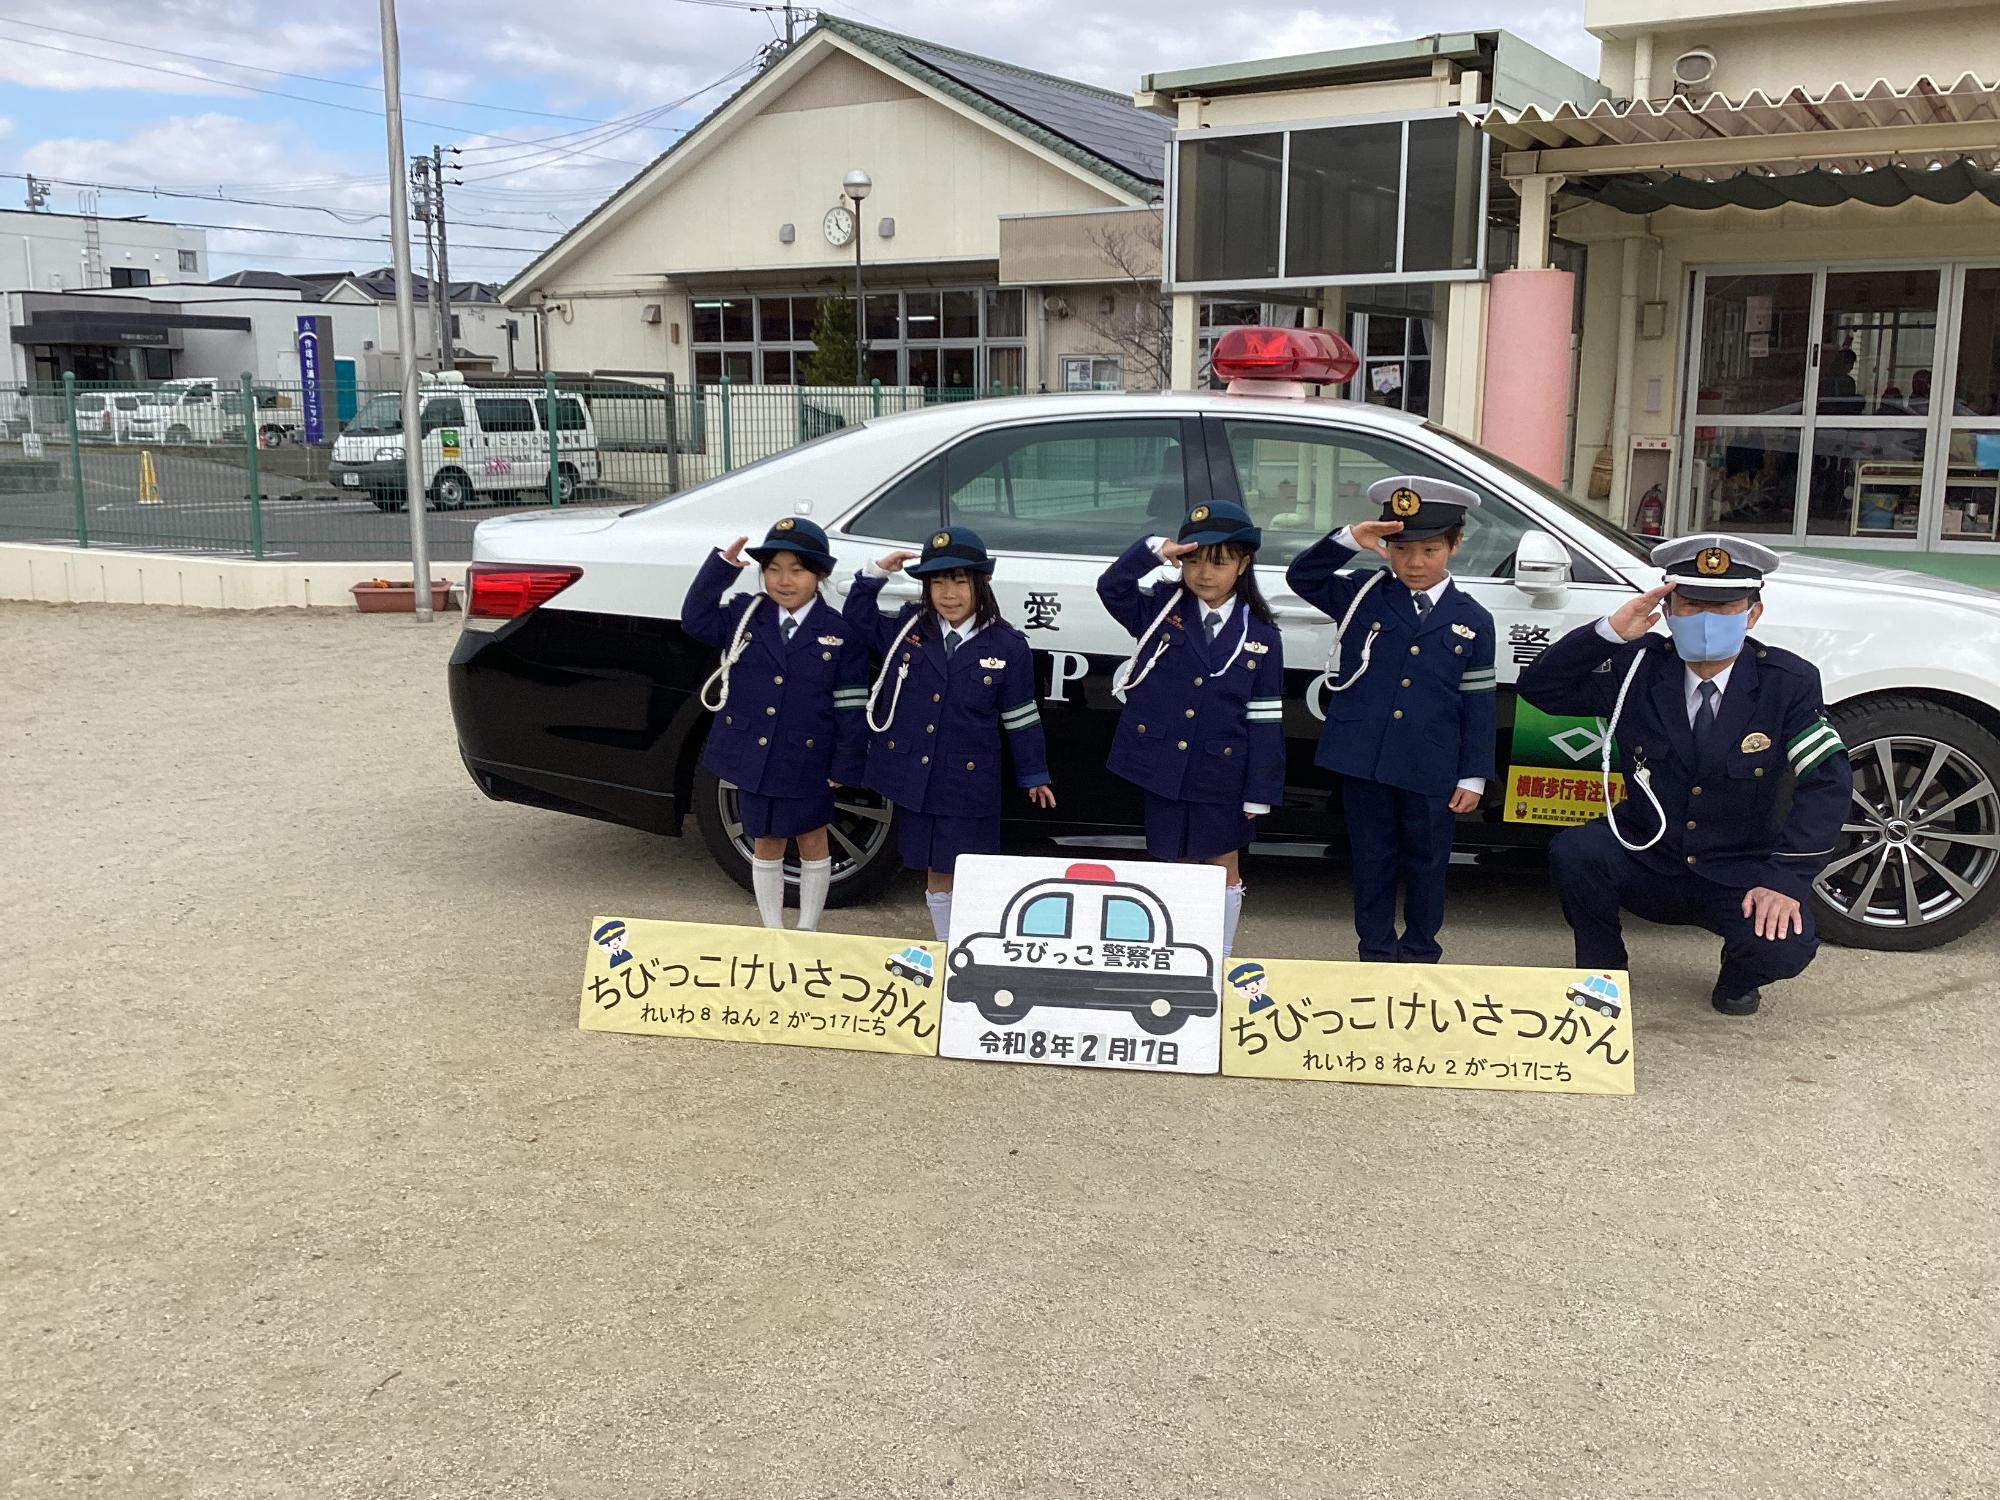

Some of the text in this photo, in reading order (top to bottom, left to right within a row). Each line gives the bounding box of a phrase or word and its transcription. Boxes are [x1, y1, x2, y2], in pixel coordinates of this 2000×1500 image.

[1024, 592, 1061, 631] 愛
[1508, 624, 1550, 664] 警
[1044, 651, 1089, 702] P
[587, 953, 936, 1038] ちびっこけいさつかん
[979, 1030, 1179, 1065] 令和8年2月17日
[1230, 992, 1629, 1066] ちびっこけいさつかん
